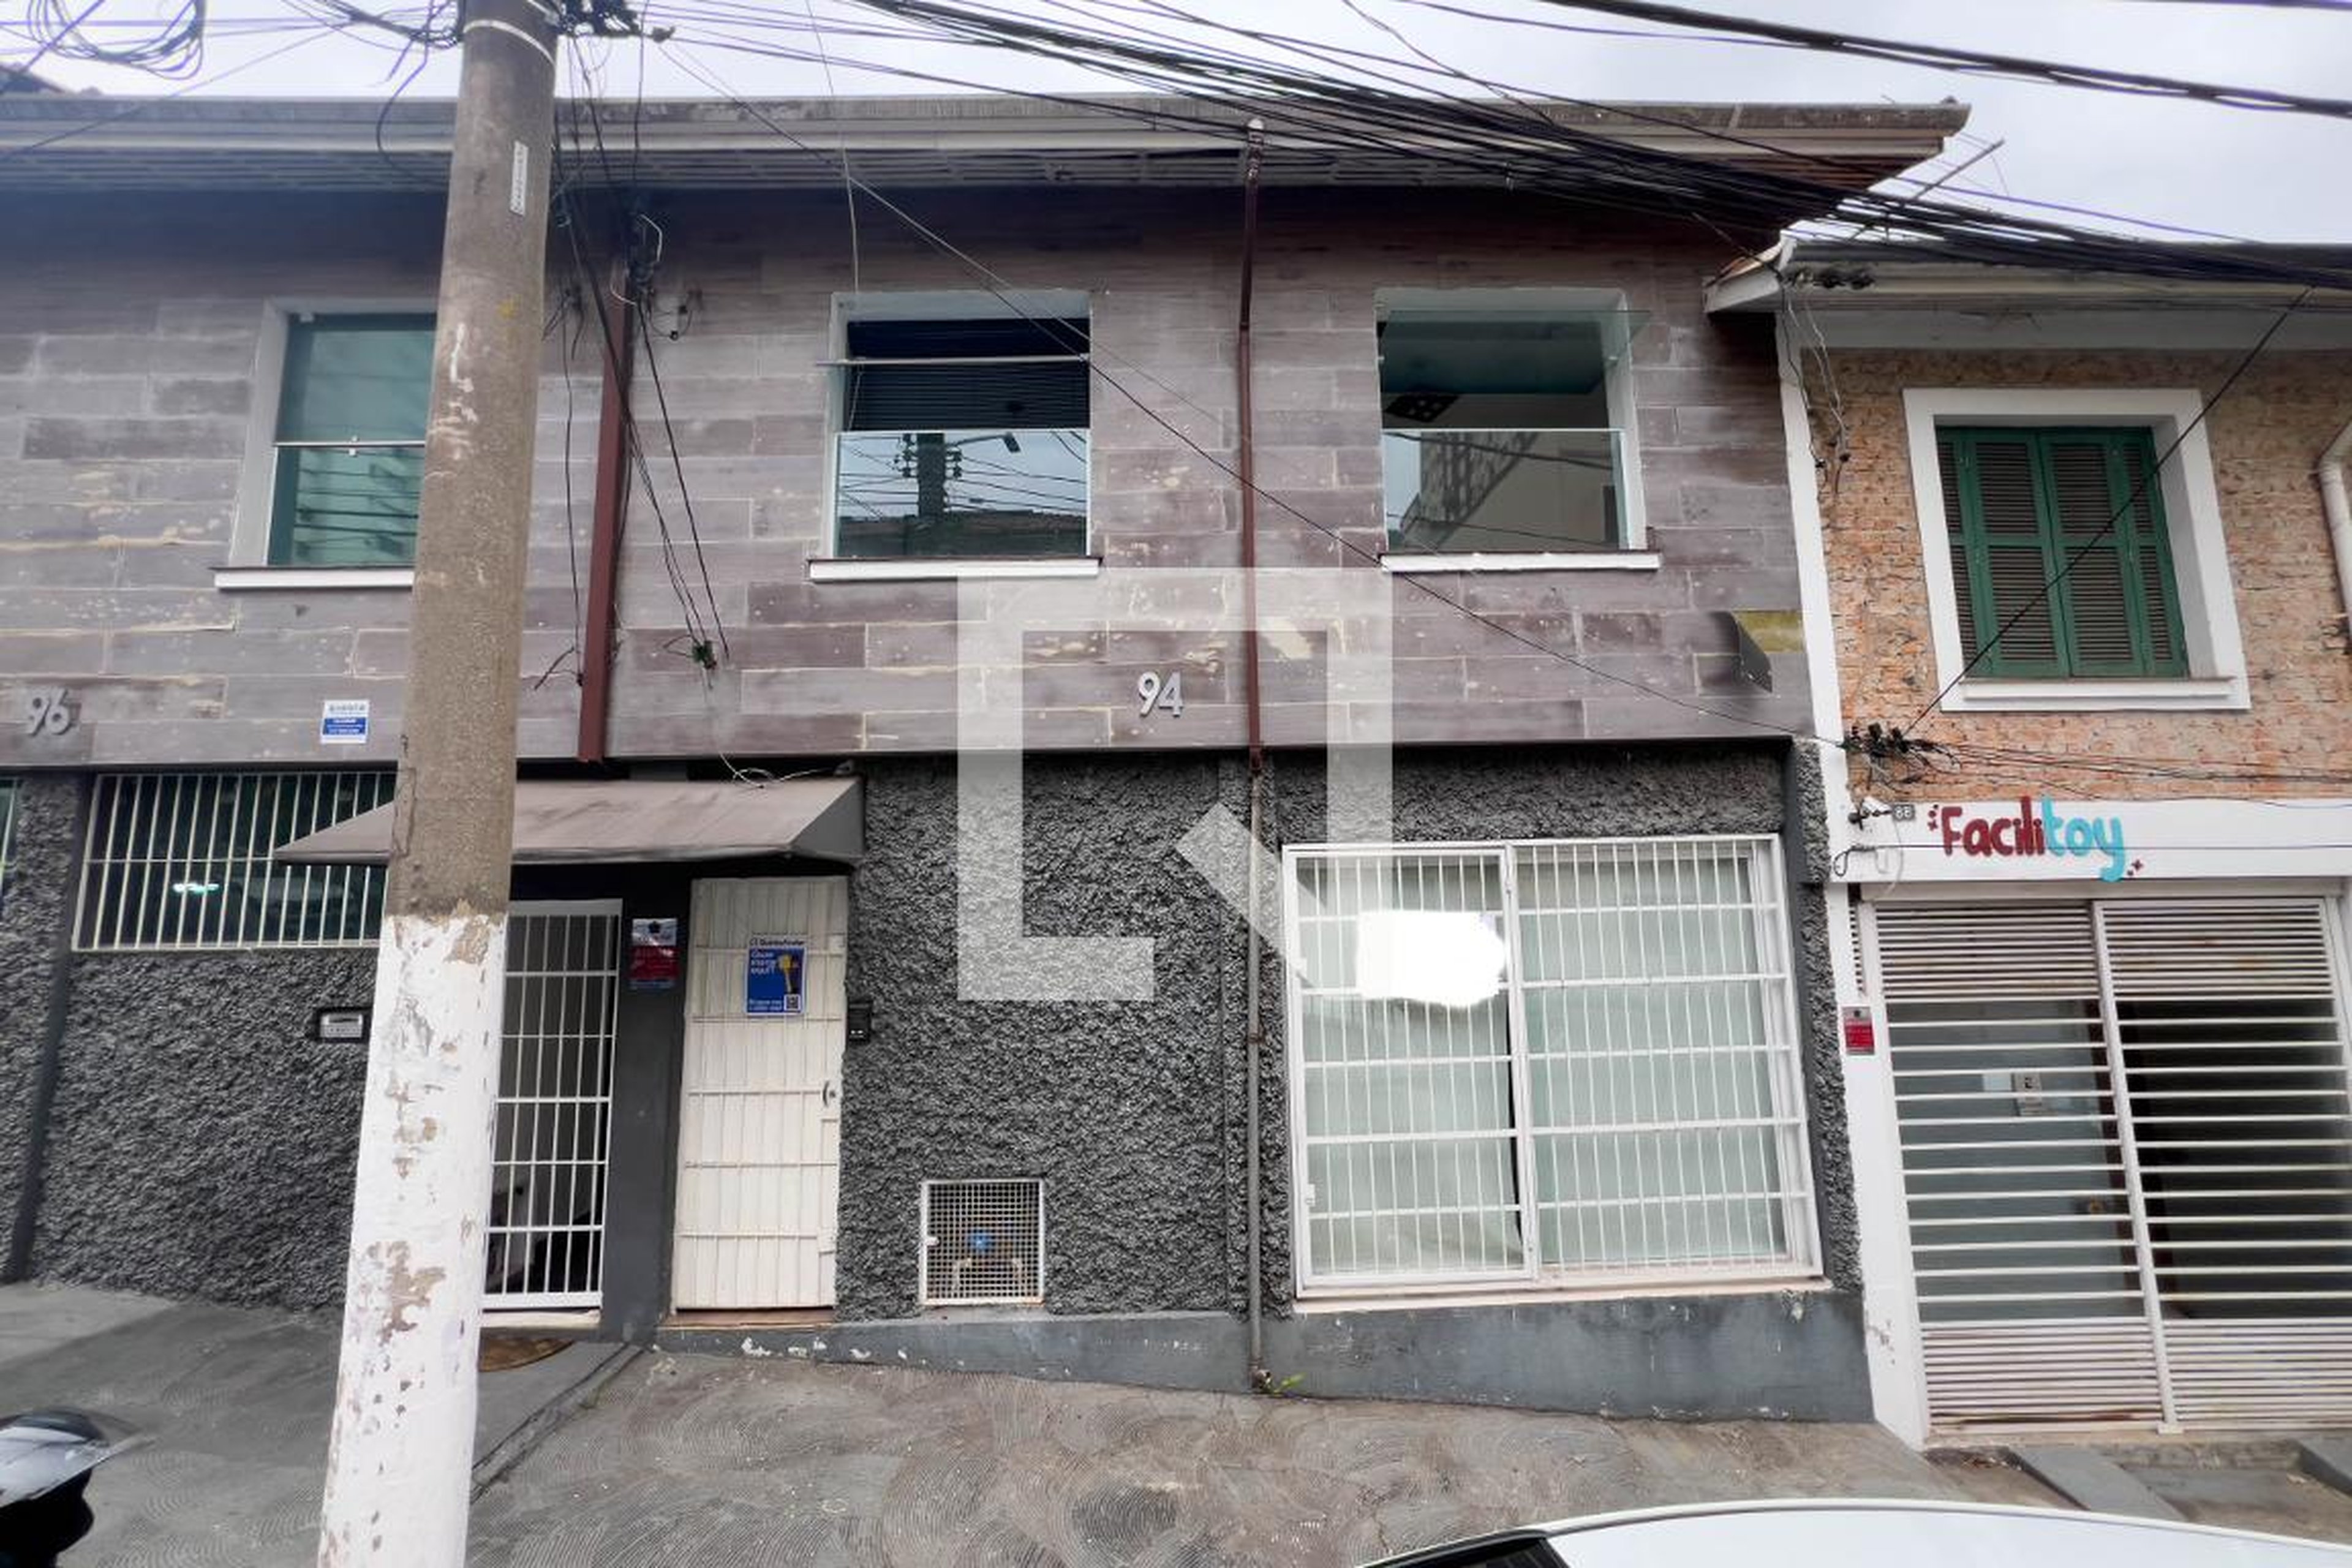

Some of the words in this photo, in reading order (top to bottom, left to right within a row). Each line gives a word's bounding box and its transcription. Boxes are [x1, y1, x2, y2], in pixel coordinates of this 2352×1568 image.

[26, 688, 70, 735] 96
[1138, 671, 1183, 717] 94
[1941, 795, 2125, 882] Facilitoy
